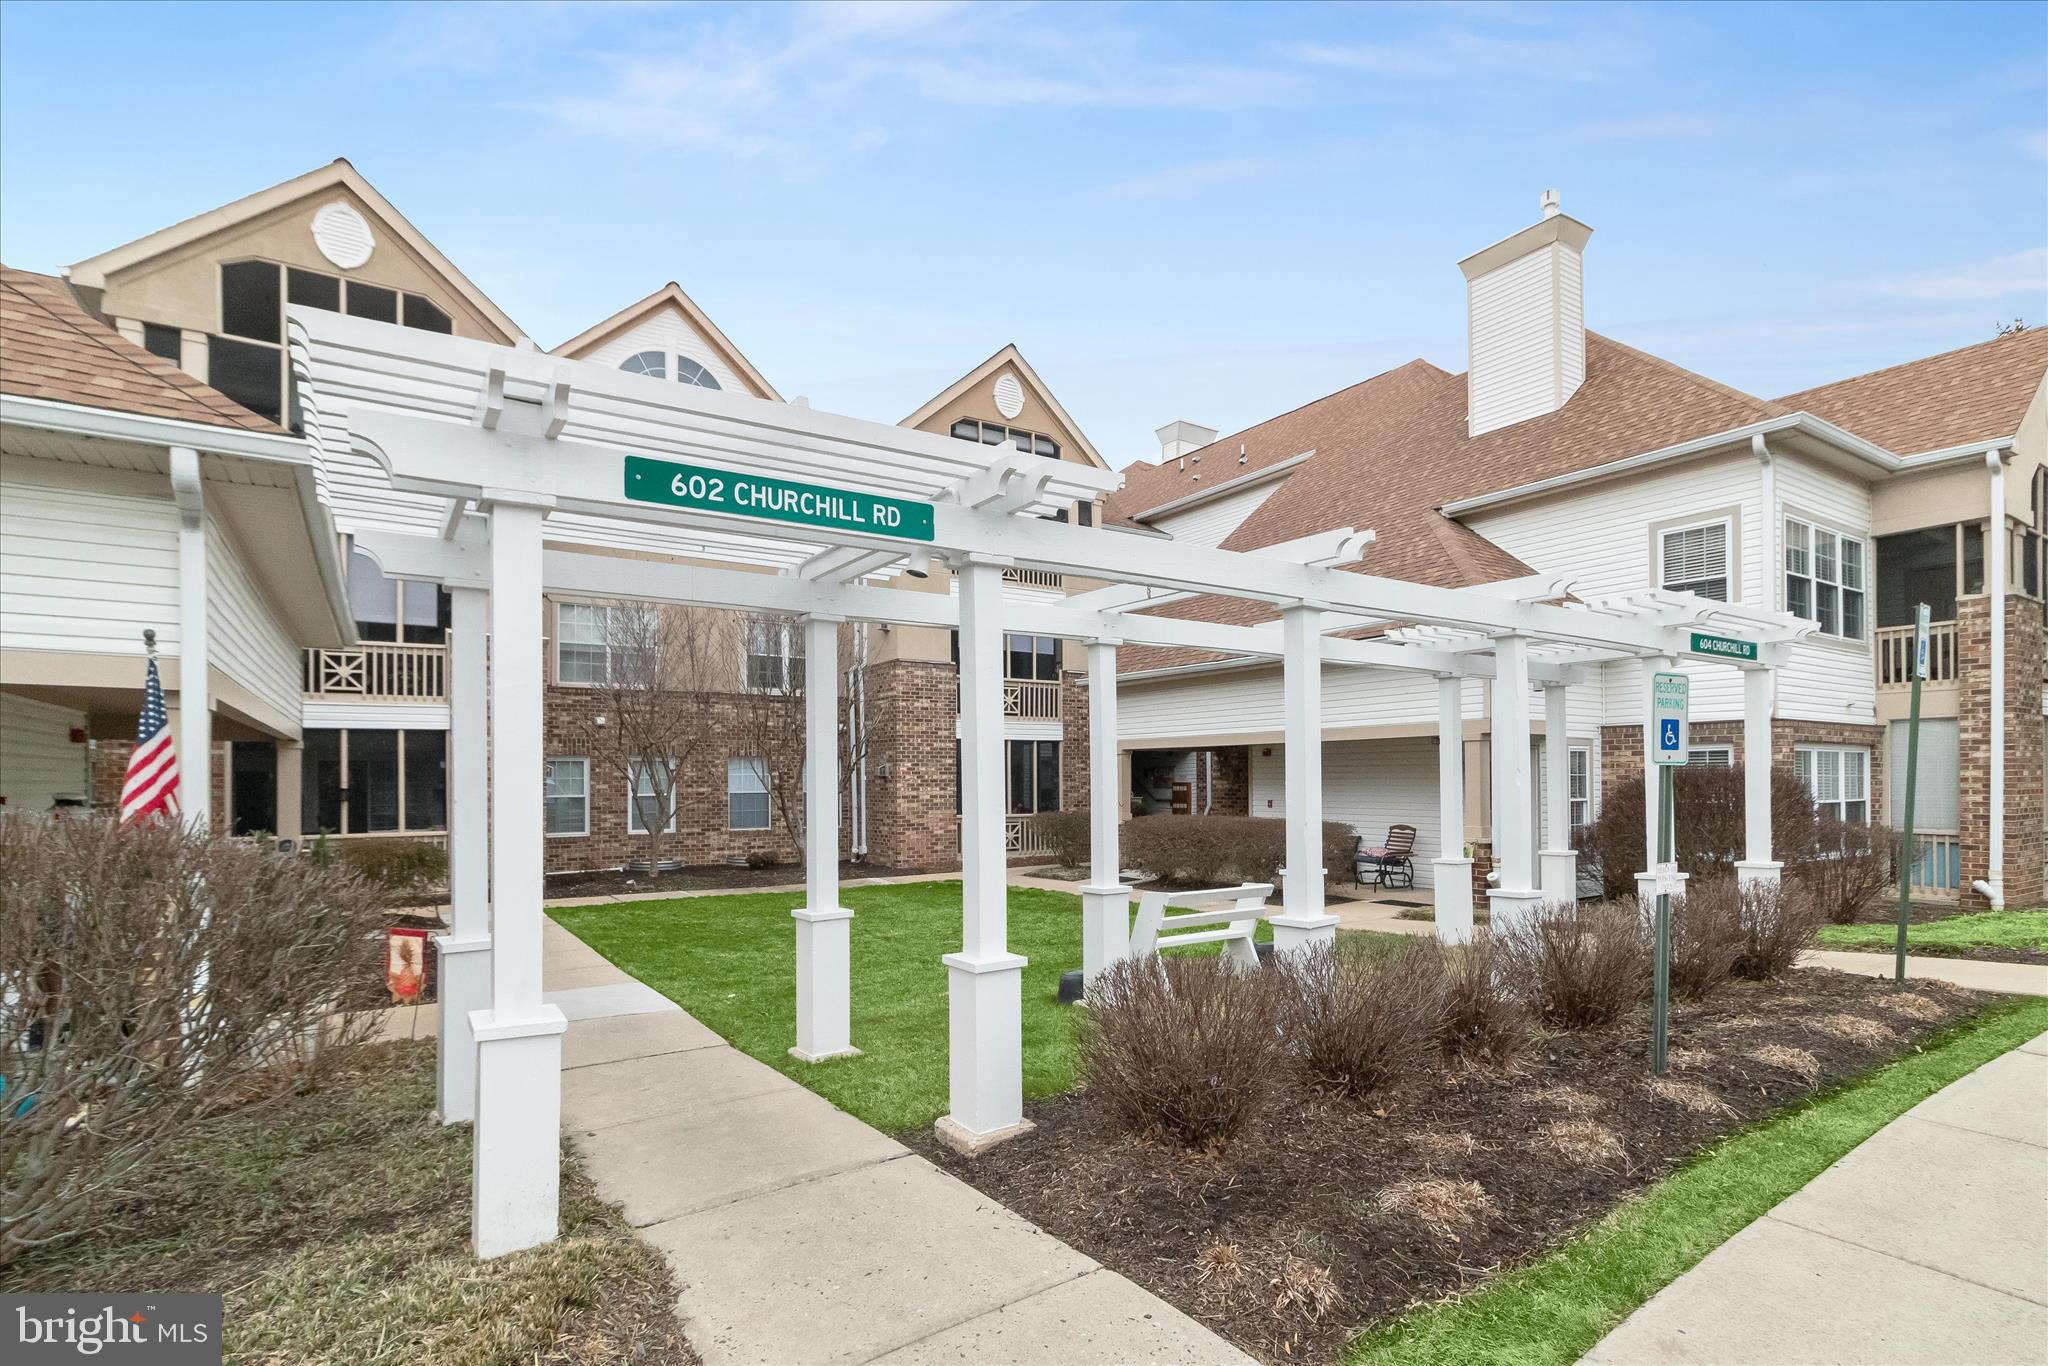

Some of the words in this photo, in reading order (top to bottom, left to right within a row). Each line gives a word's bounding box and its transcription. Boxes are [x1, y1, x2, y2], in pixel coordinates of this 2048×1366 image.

[671, 473, 724, 502] 602
[734, 482, 866, 522] CHURCHILL
[873, 504, 901, 527] RD
[1700, 638, 1712, 650] 604
[1712, 640, 1742, 655] CHURCHILL
[1743, 645, 1751, 656] RD
[1655, 681, 1687, 695] RESERVED
[1657, 697, 1685, 711] PARKING
